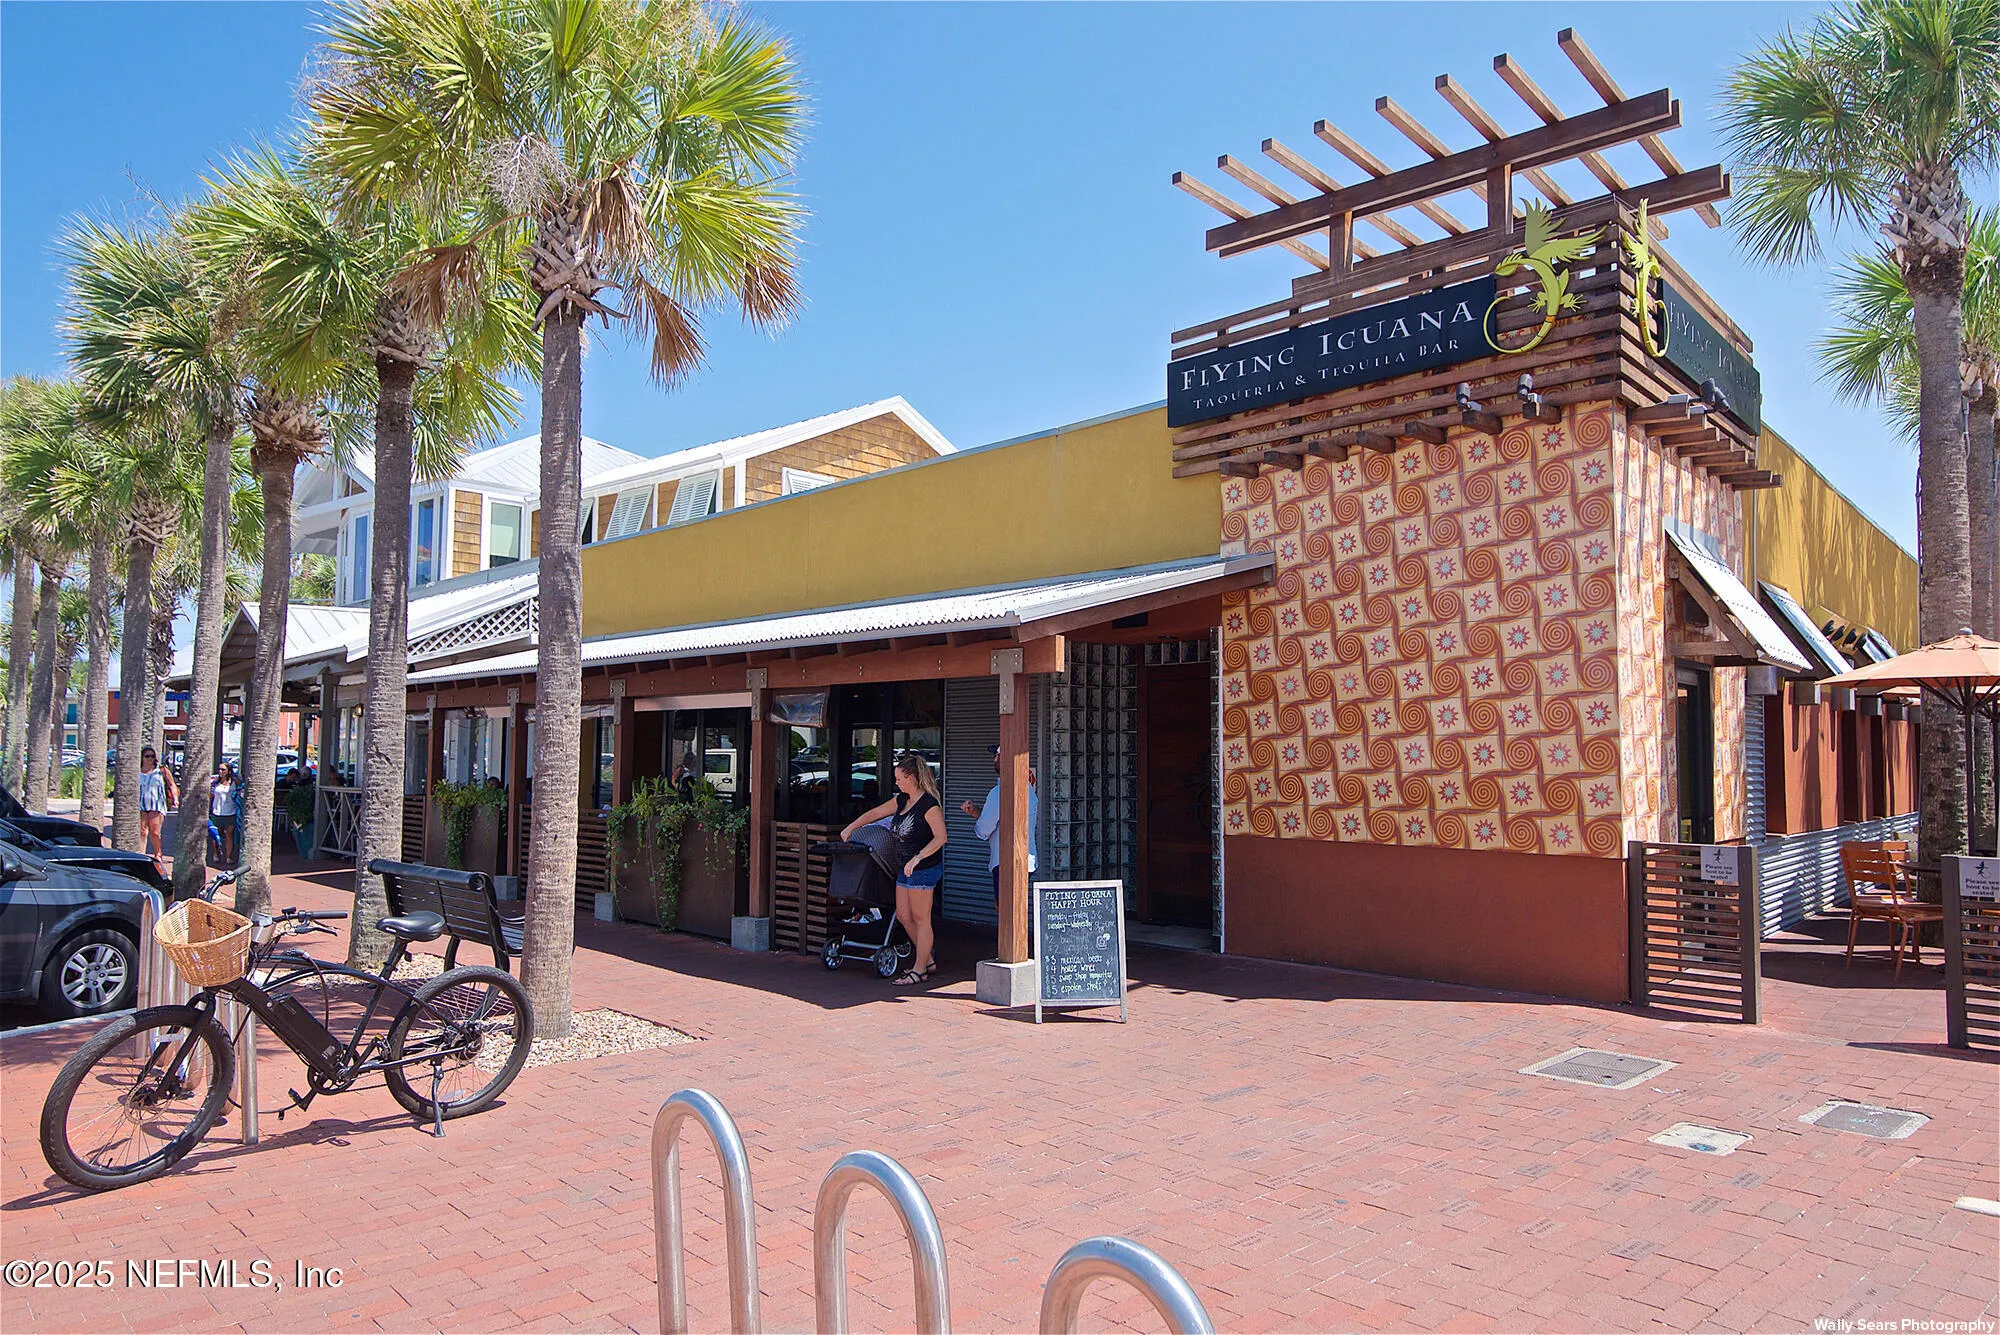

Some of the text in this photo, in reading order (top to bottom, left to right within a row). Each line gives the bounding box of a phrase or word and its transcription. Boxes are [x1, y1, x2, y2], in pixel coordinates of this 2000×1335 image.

[1180, 300, 1477, 391] FLYING IGUANA
[1193, 339, 1459, 409] TAQUERIA & TEQUILA BAR
[1045, 892, 1077, 900] FLYING
[1051, 899, 1102, 909] HAPPY HOUR
